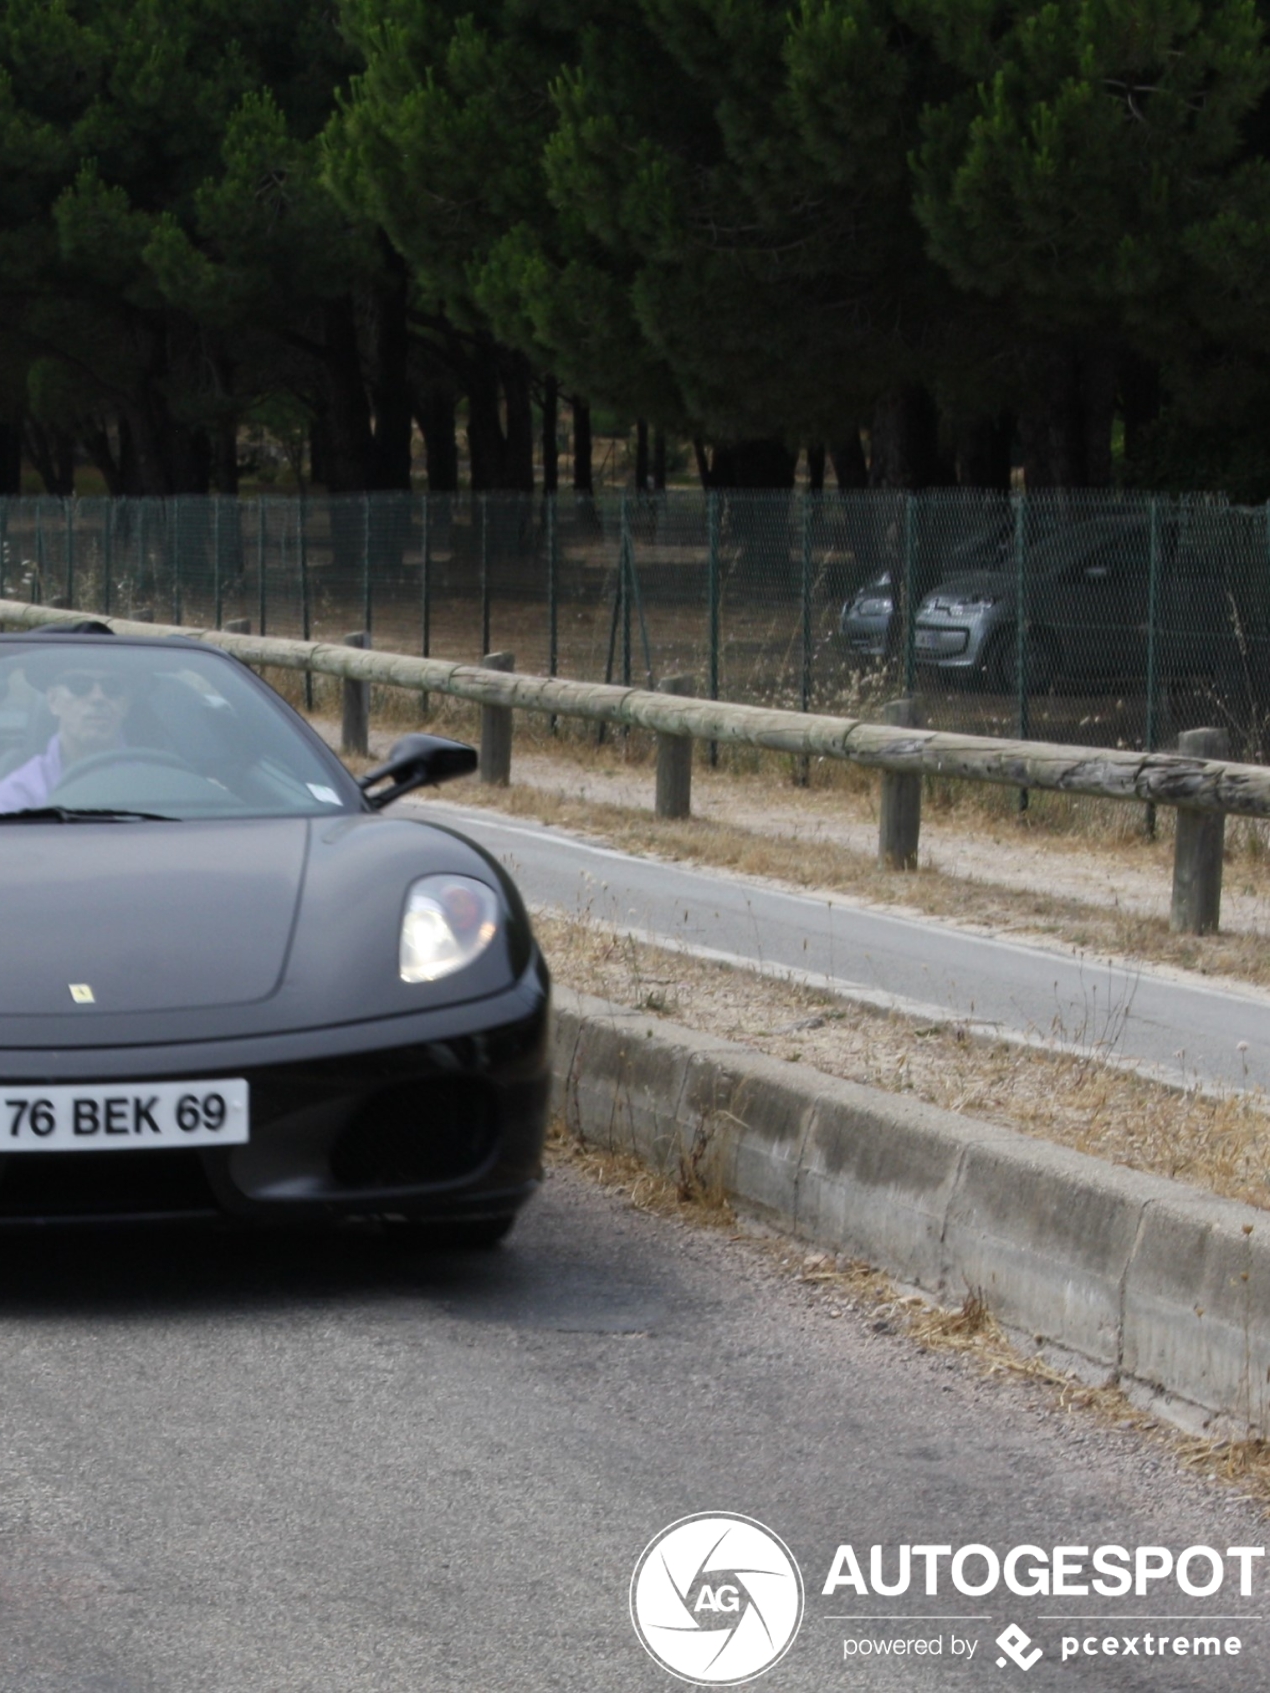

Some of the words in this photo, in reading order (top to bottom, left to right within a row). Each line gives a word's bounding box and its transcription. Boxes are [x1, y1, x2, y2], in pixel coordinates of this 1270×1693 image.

[5, 1098, 56, 1138] 76
[73, 1095, 162, 1136] BEK
[176, 1092, 227, 1133] 69
